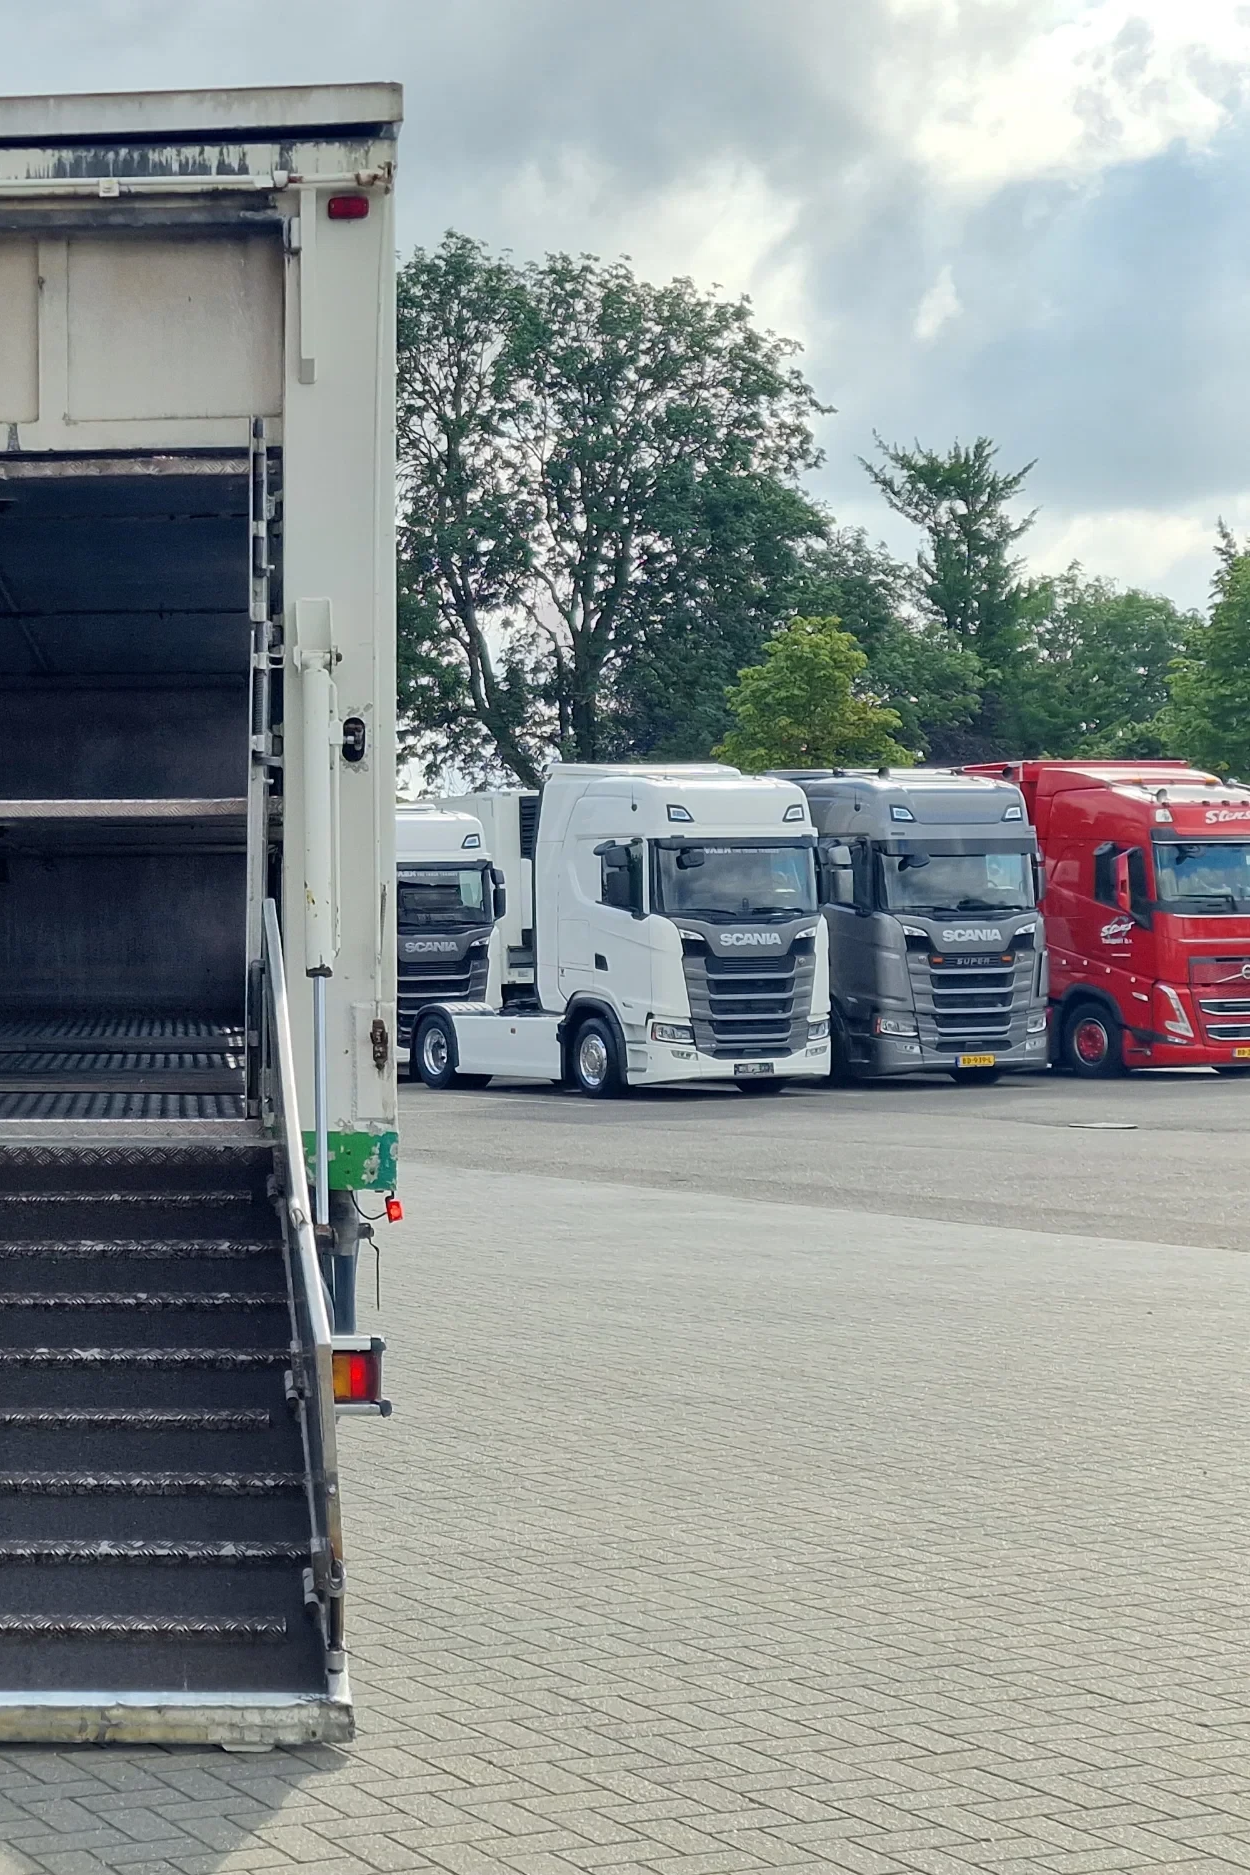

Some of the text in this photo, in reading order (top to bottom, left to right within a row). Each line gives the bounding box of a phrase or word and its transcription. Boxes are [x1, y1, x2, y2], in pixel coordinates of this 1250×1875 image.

[719, 932, 782, 946] SCANIA
[942, 928, 1003, 942] SCANIA
[405, 941, 459, 953] SCANIA
[956, 957, 991, 965] SUPER
